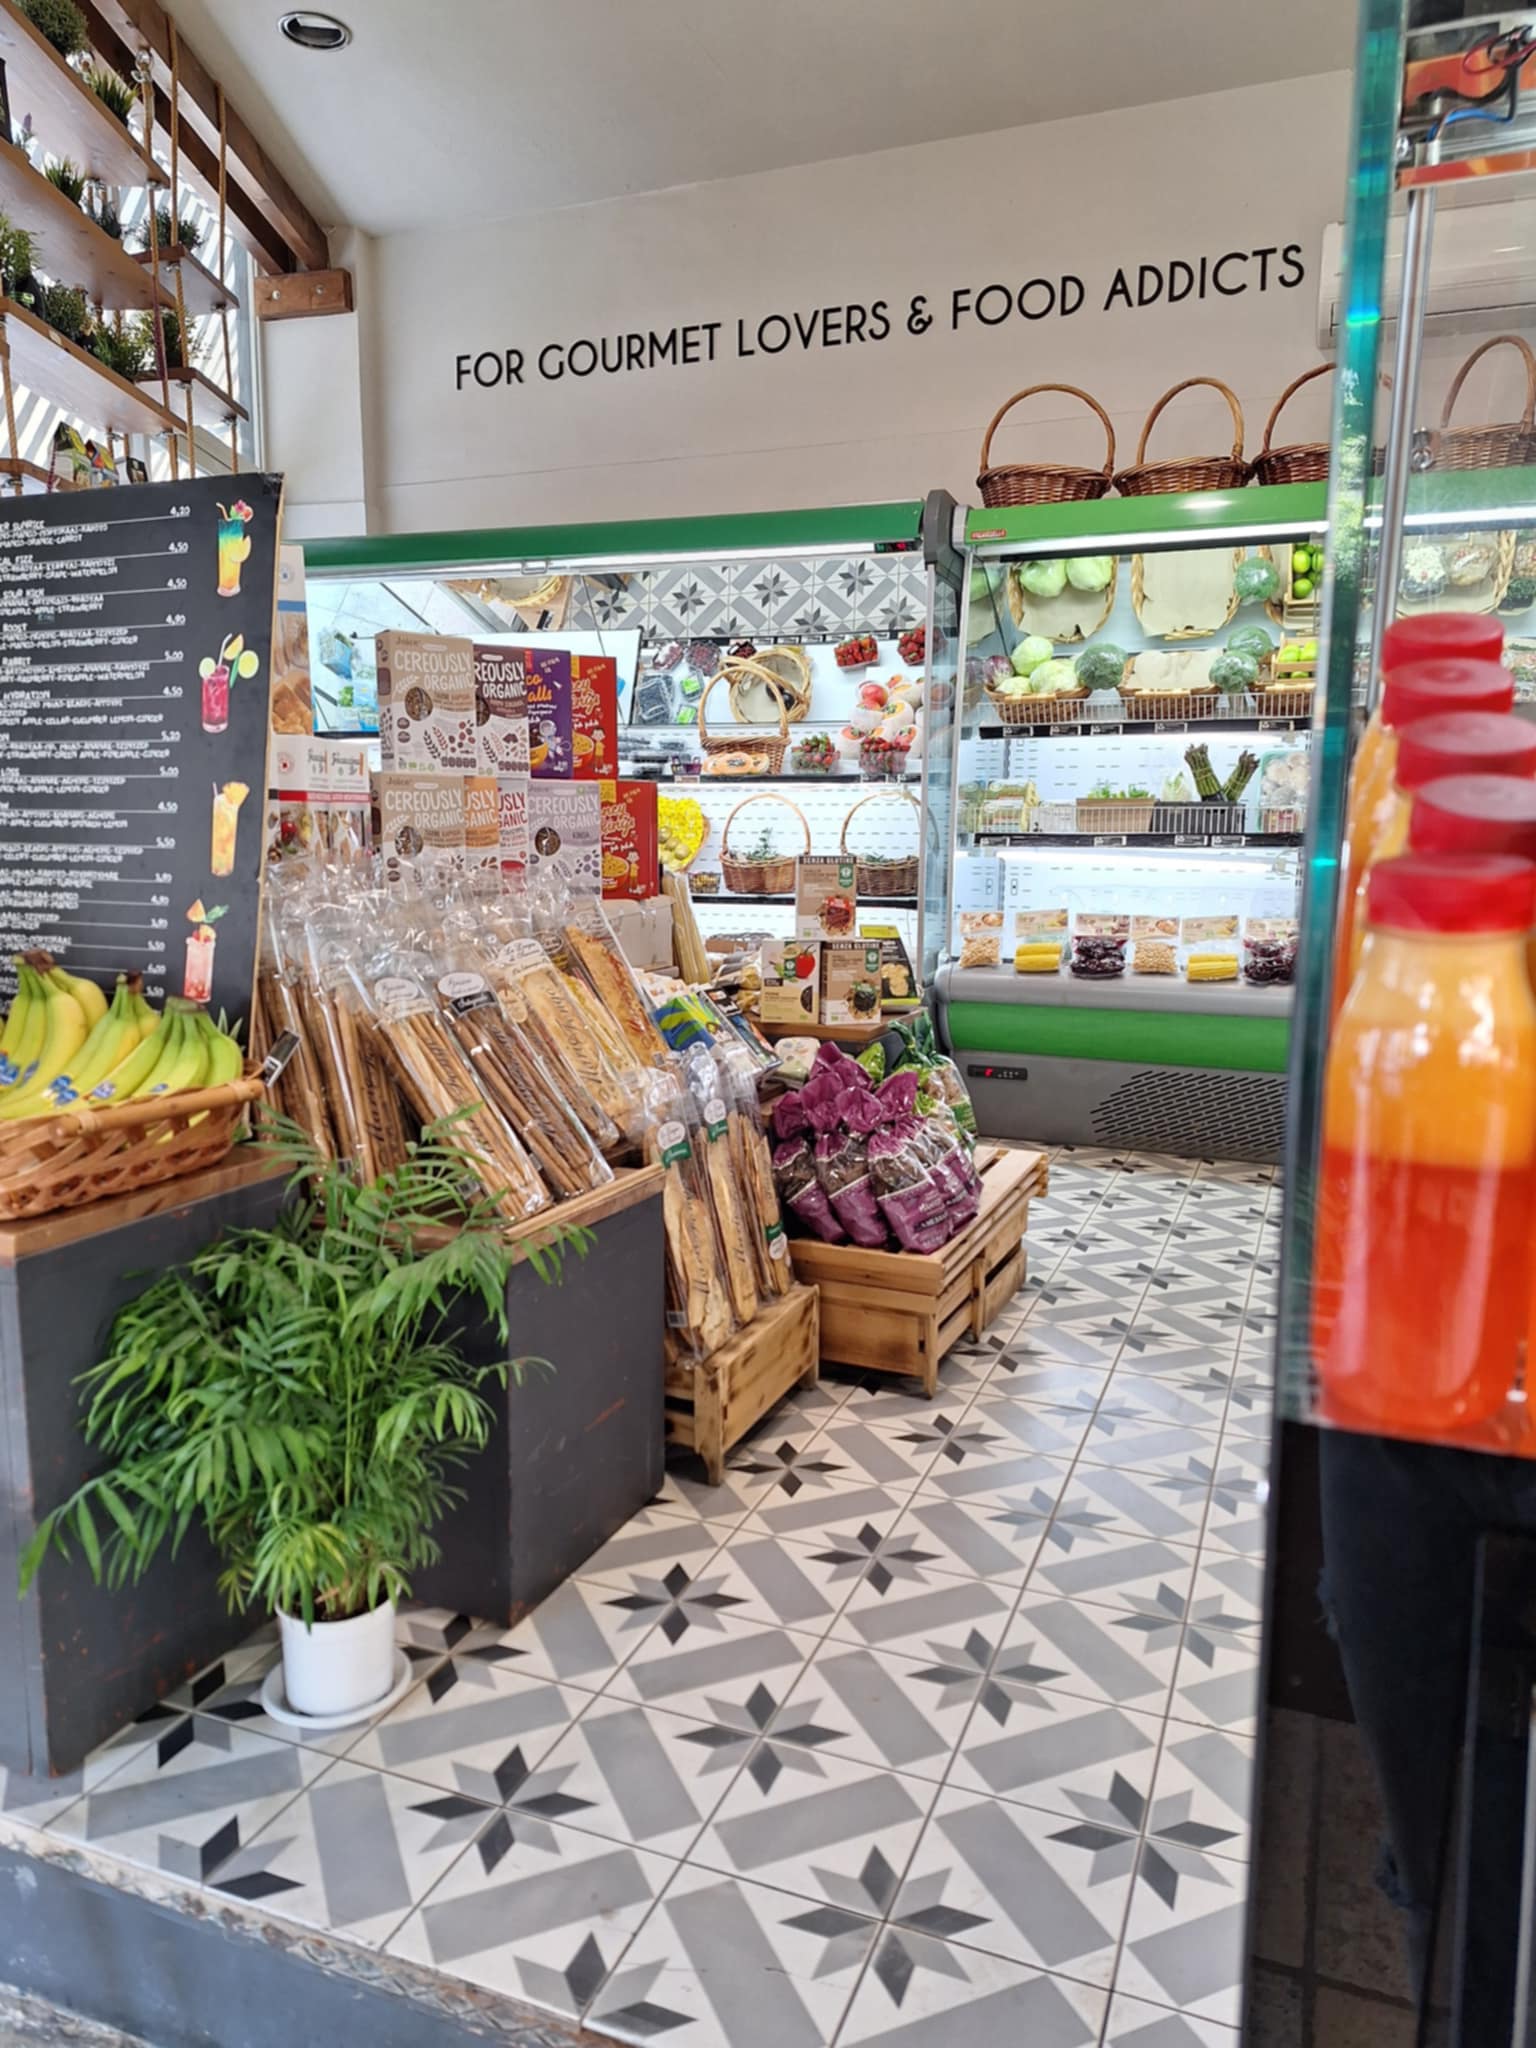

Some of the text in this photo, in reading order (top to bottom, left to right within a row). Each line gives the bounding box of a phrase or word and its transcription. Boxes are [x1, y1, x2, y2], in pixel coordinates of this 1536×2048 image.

[456, 244, 1305, 390] FOR GOURMET LOVERS & FOOD ADDICTS
[394, 649, 473, 673] CEREOUSLY
[423, 673, 475, 690] ORGANIC
[482, 681, 527, 699] ORGANIC
[385, 788, 464, 811] CEREOUSLY
[528, 794, 599, 815] CEREOUSLY
[414, 809, 464, 829] ORGANIC
[553, 813, 600, 829] ORGANIC
